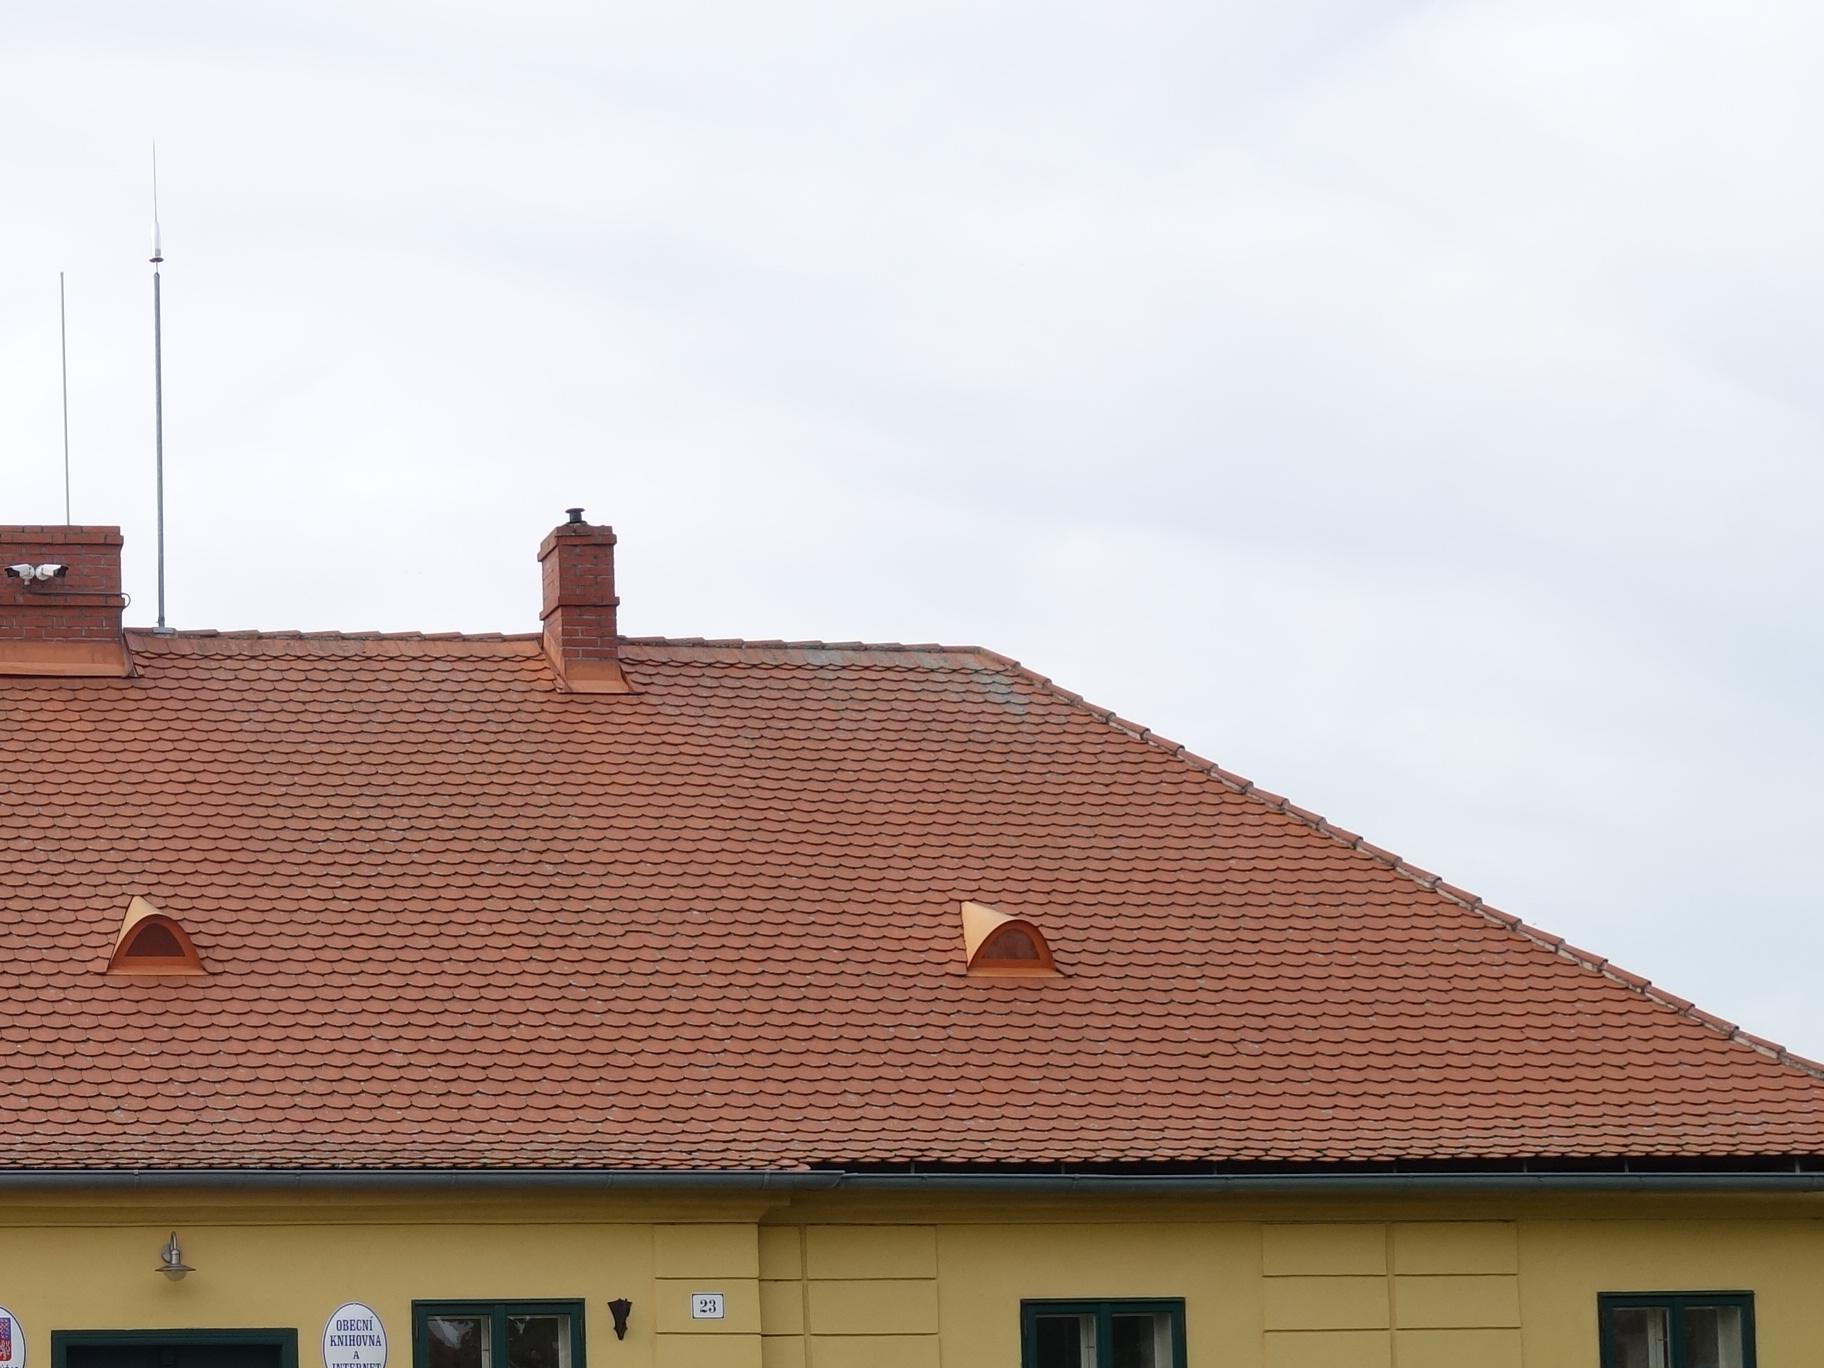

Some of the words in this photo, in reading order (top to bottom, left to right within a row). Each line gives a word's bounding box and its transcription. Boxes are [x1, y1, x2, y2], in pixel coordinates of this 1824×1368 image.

[700, 1298, 716, 1313] 23
[336, 1316, 374, 1332] OBECNÍ
[330, 1334, 382, 1346] KNIHOVNA
[352, 1350, 360, 1360] A
